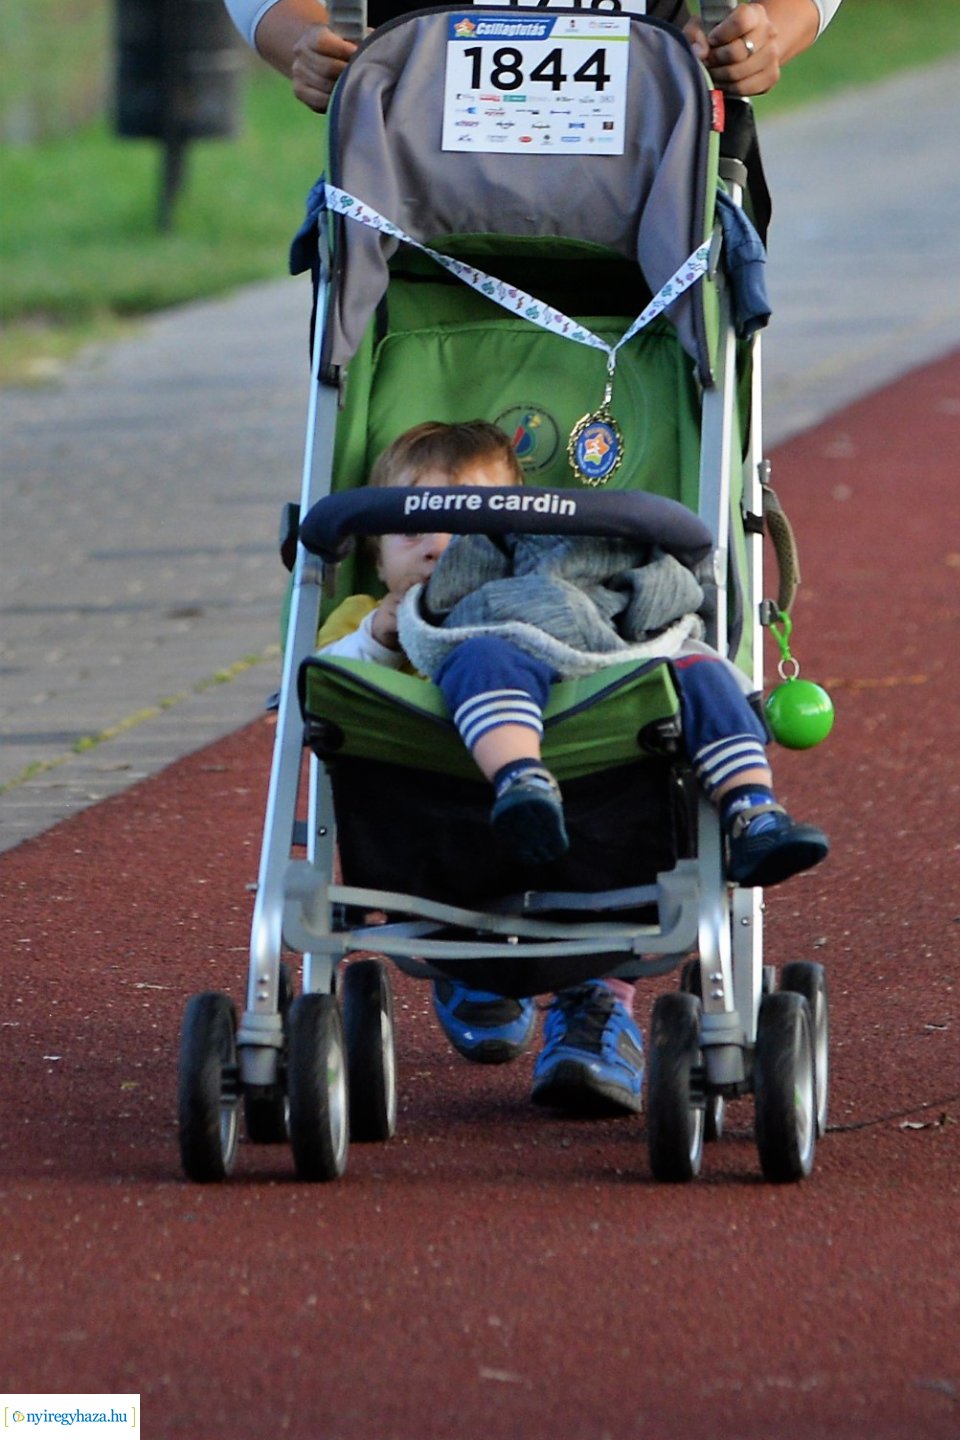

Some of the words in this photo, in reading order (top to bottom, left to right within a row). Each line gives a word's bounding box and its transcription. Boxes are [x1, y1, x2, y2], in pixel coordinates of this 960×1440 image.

[463, 46, 611, 92] 1844
[404, 491, 482, 516] pierre
[488, 493, 577, 517] cardin
